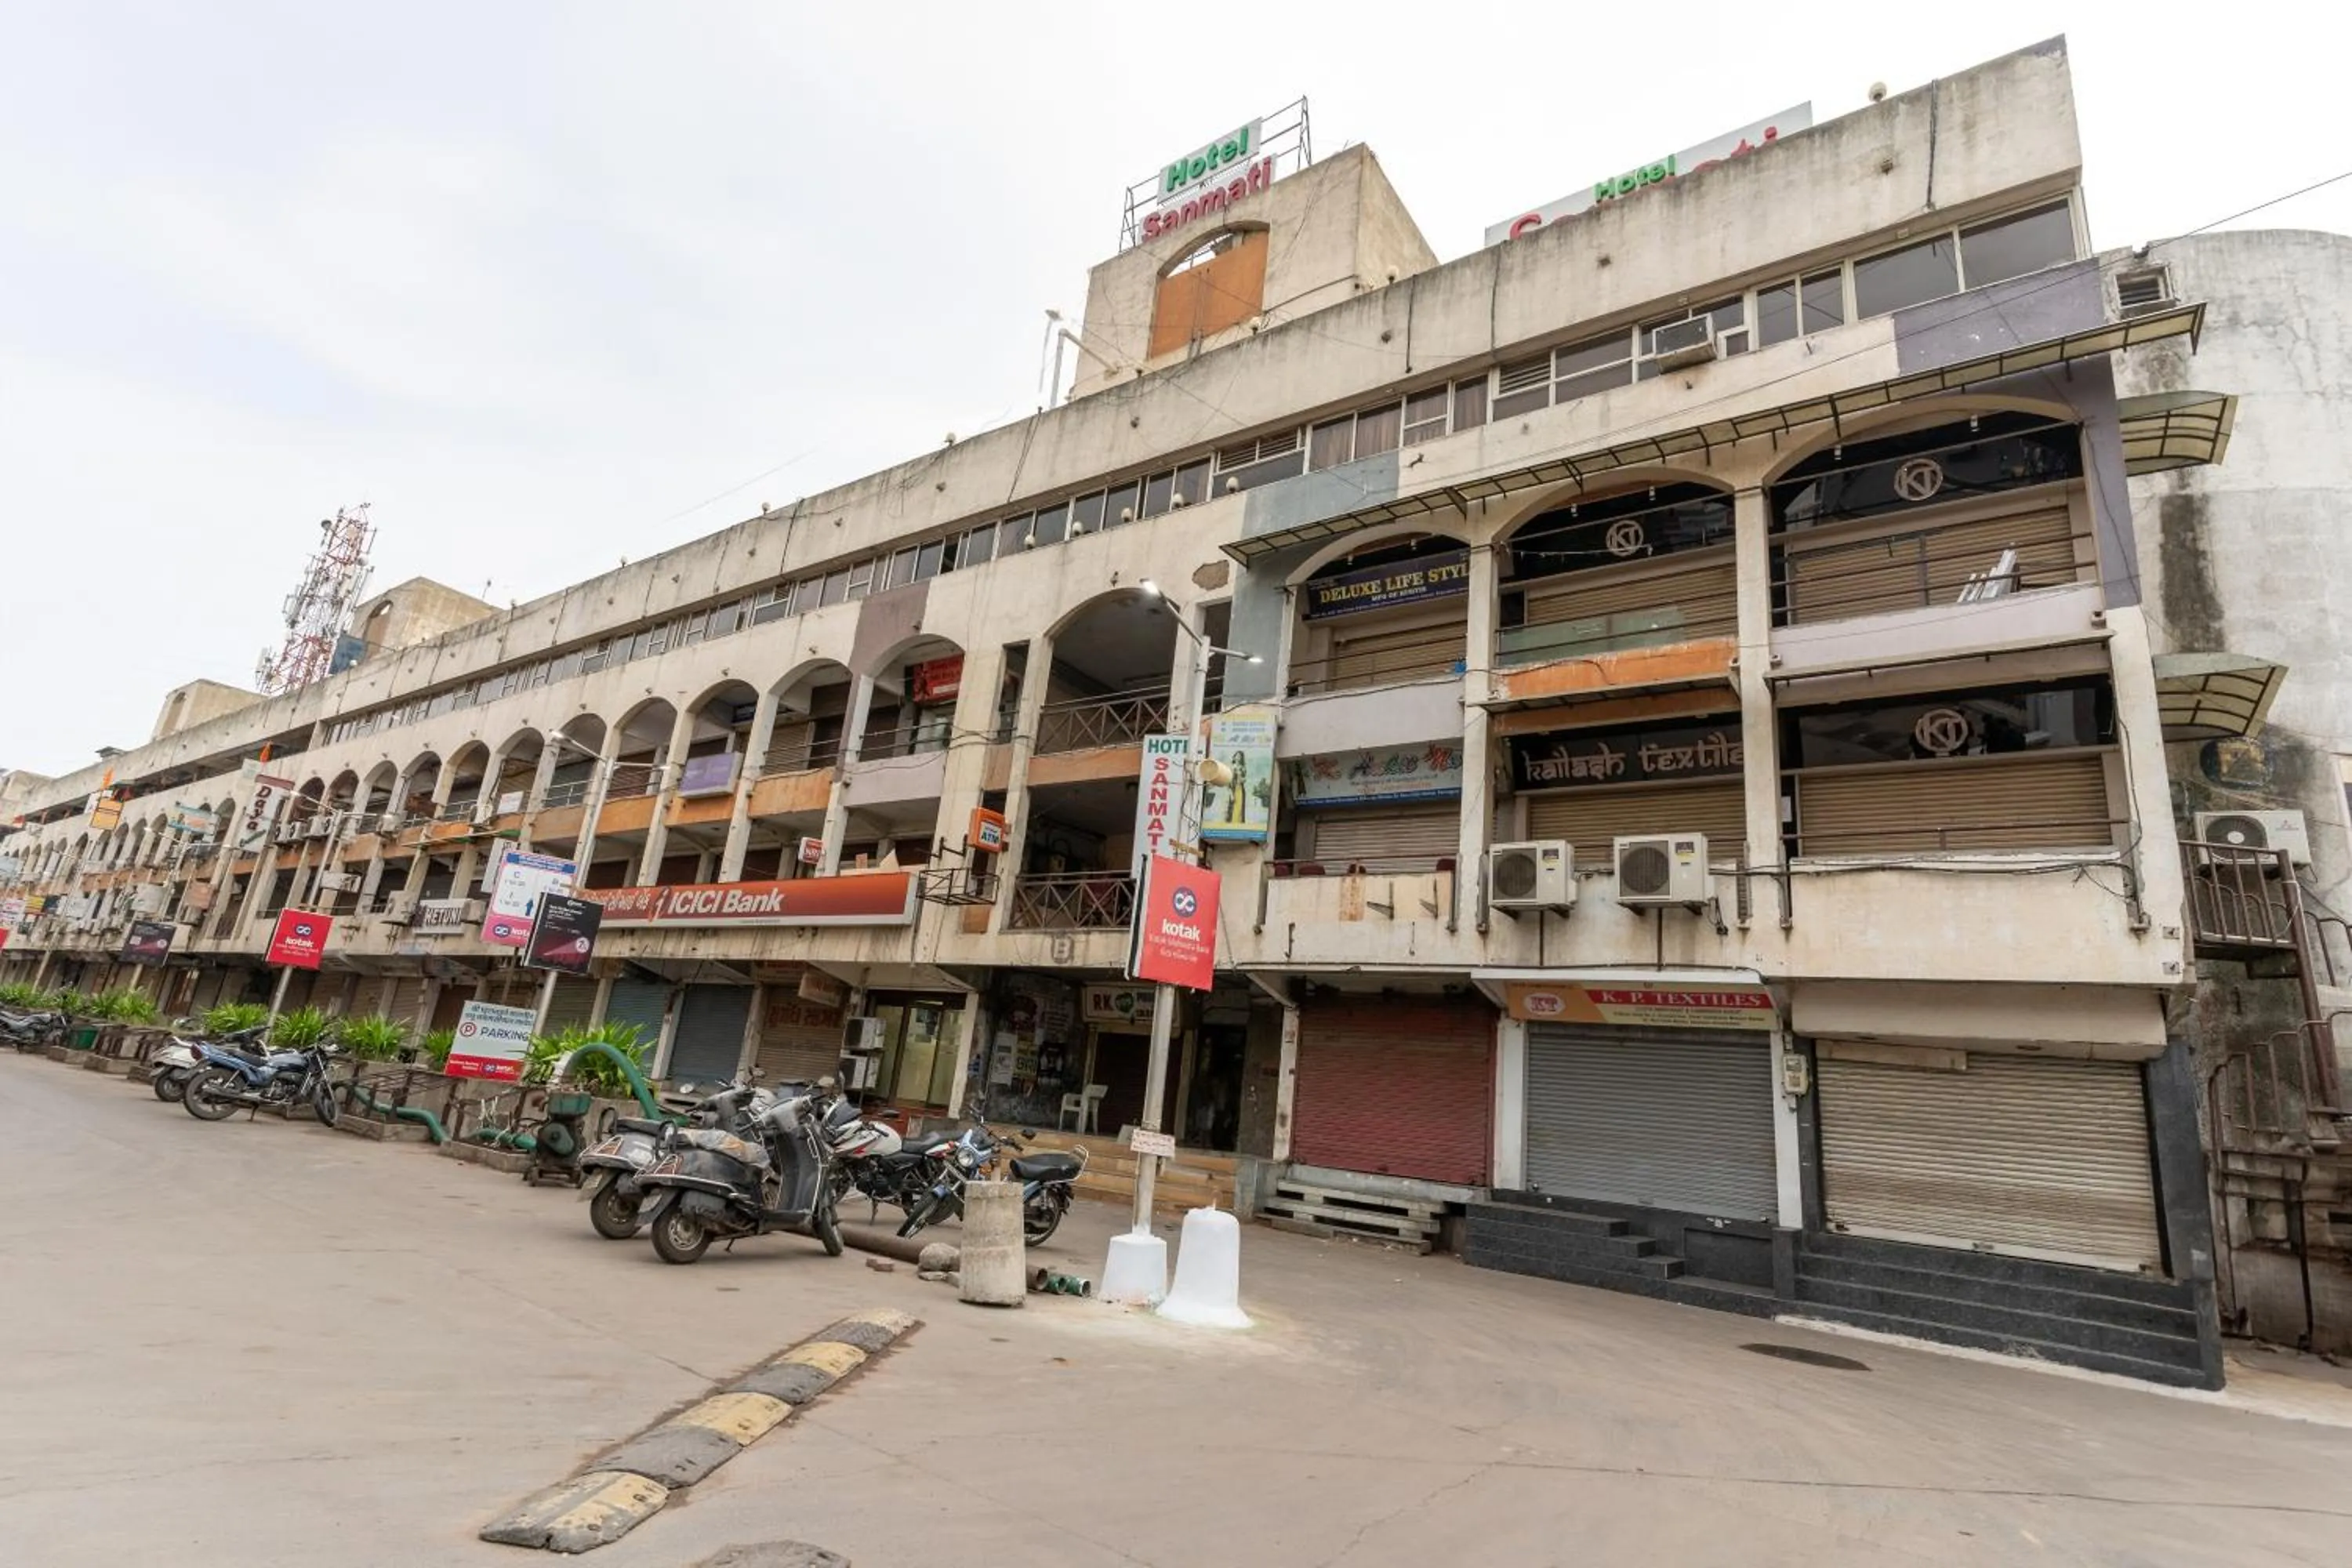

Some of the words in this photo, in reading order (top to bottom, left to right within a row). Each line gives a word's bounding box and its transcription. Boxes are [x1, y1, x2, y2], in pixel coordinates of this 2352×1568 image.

[1166, 125, 1249, 192] Hotel
[1595, 154, 1676, 203] Hotel
[1142, 155, 1272, 243] Sanmati
[1320, 579, 1381, 603] DELUXE
[1385, 572, 1424, 590] LIFE
[1147, 757, 1169, 853] SANMAT
[667, 889, 725, 915] ICICI
[722, 887, 786, 914] Bank
[1162, 918, 1200, 941] kotak
[1602, 991, 1622, 1004] K.
[1631, 992, 1645, 1004] P.
[1656, 993, 1762, 1007] TEXTILES
[480, 1025, 529, 1042] PARKING
